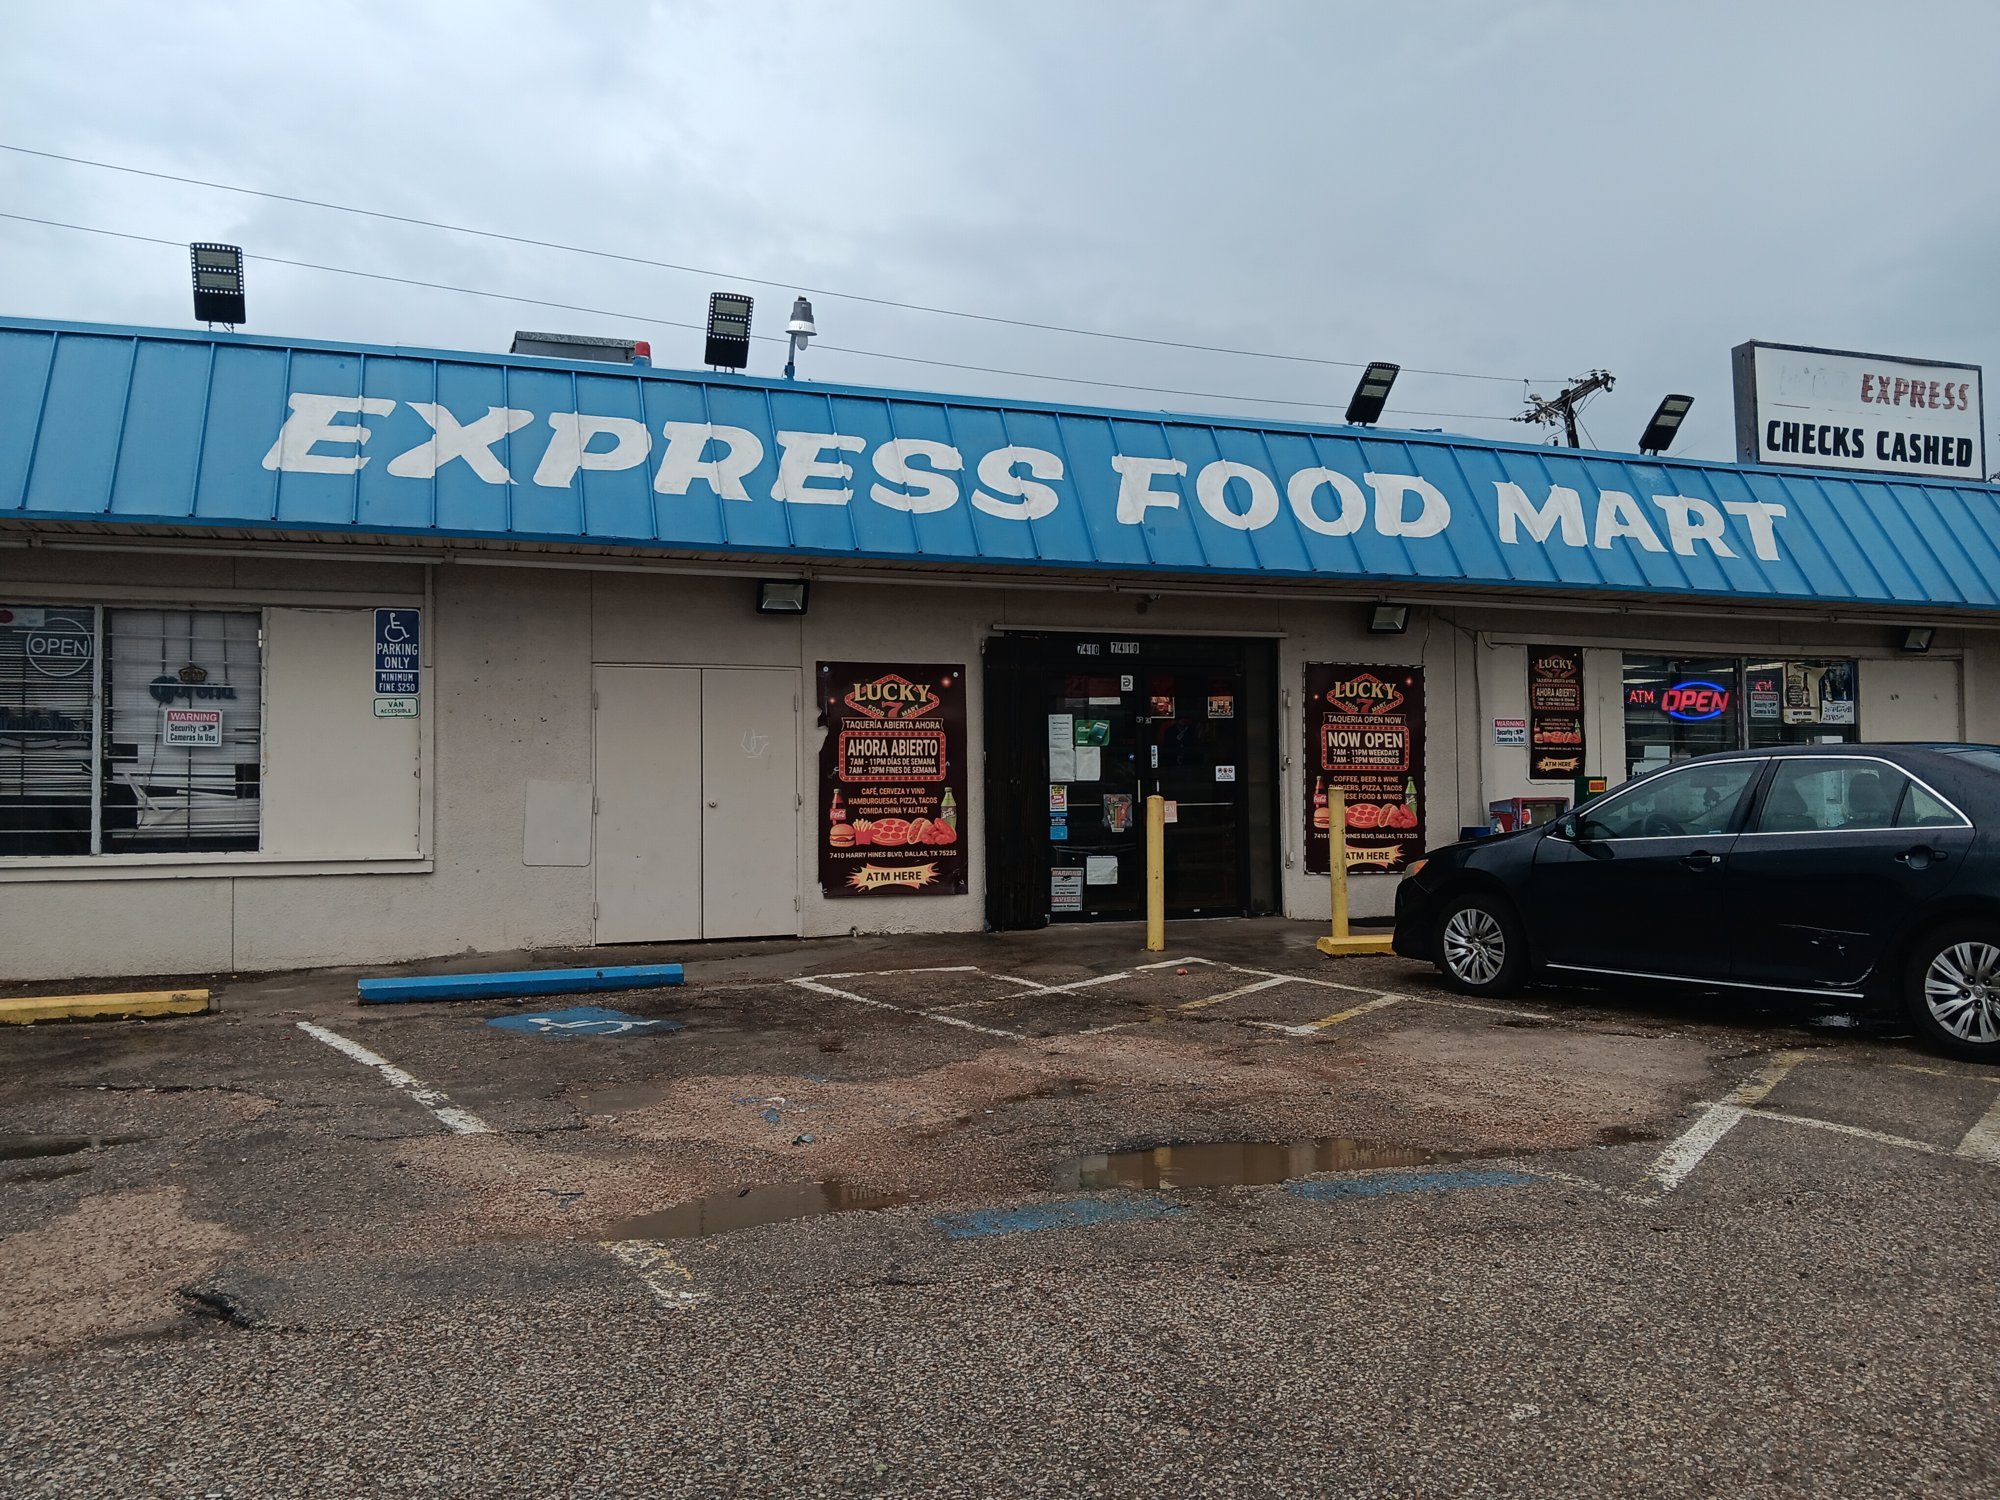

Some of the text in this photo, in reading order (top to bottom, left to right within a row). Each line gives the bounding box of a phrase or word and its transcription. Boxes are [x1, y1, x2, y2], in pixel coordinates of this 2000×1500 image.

[1860, 373, 1970, 411] EXPRESS
[1766, 420, 1973, 467] CHECKS CASHED
[262, 392, 1787, 561] EXPRESS FOOD MART
[30, 638, 88, 656] OPEN
[376, 643, 418, 656] PARKING
[1111, 642, 1139, 654] 7410
[384, 656, 410, 669] ONLY
[1539, 659, 1573, 669] LUCKY
[381, 673, 414, 682] MINIMUM
[379, 682, 415, 692] FINE $250
[853, 683, 931, 702] LUCKY
[1334, 681, 1396, 700] LUCKY
[1345, 698, 1386, 713] FOOD 7 MART
[1630, 689, 1730, 712] ATM OPEN
[868, 701, 919, 718] FOOD 7 MART
[170, 712, 217, 721] WARNING
[1328, 715, 1363, 723] TAQUERIA
[1364, 716, 1383, 724] OPEN
[170, 724, 196, 733] Security
[883, 721, 913, 729] ABIERTA
[915, 721, 940, 729] AHORA
[170, 733, 196, 741] Cameras
[197, 733, 203, 741] In
[1328, 732, 1403, 748] NOW OPEN
[848, 739, 938, 756] AHORA ABIERTO
[850, 758, 864, 766] 7AM
[848, 766, 862, 774] 7AM
[868, 766, 885, 774] 12PM
[886, 766, 902, 774] FINES
[904, 766, 911, 774] DE
[912, 766, 937, 774] SEMANA
[918, 796, 937, 804] TACOS
[908, 806, 928, 814] ALITAS
[1367, 852, 1390, 860] HERE
[866, 871, 922, 881] ATM HERE
